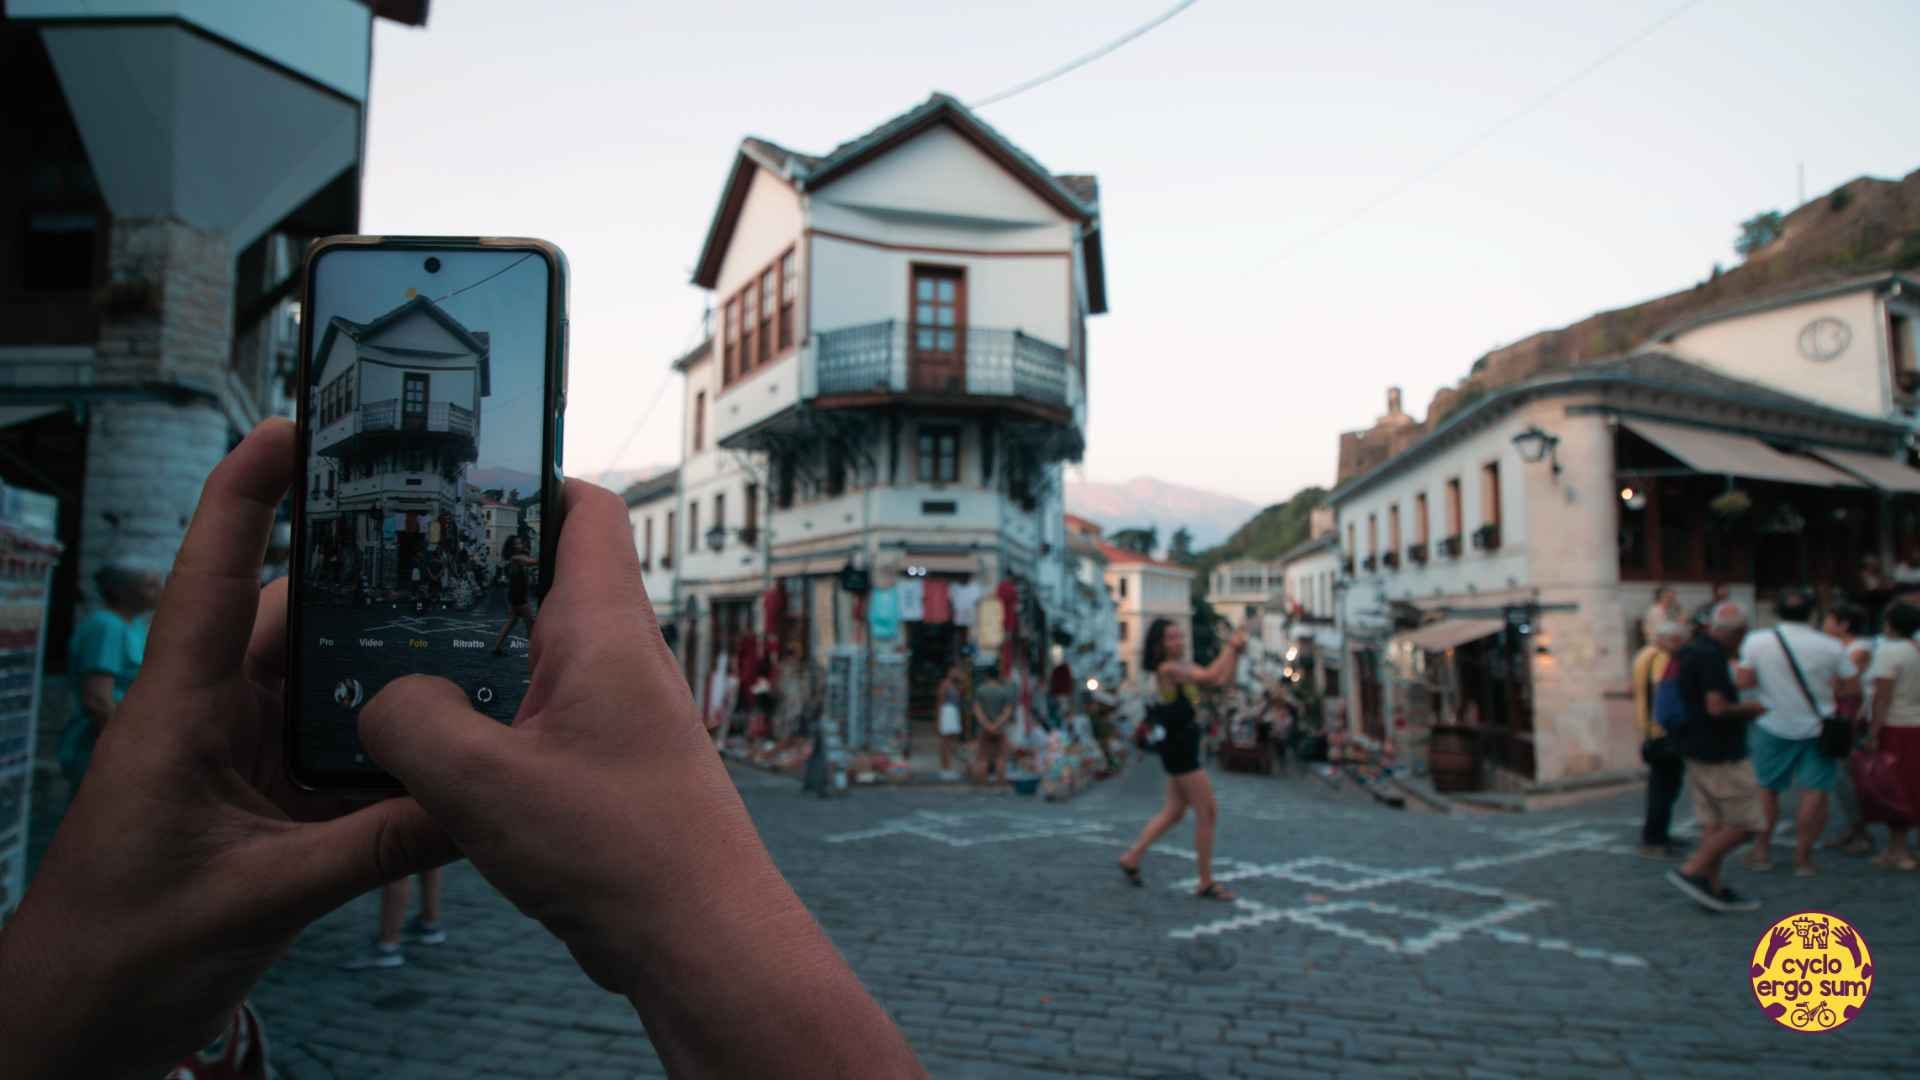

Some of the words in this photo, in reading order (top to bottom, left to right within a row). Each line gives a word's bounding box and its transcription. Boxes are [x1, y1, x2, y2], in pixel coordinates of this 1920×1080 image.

[319, 637, 334, 647] Pro
[359, 637, 384, 648] Video
[409, 638, 429, 648] Foto
[453, 639, 485, 649] Ritratto
